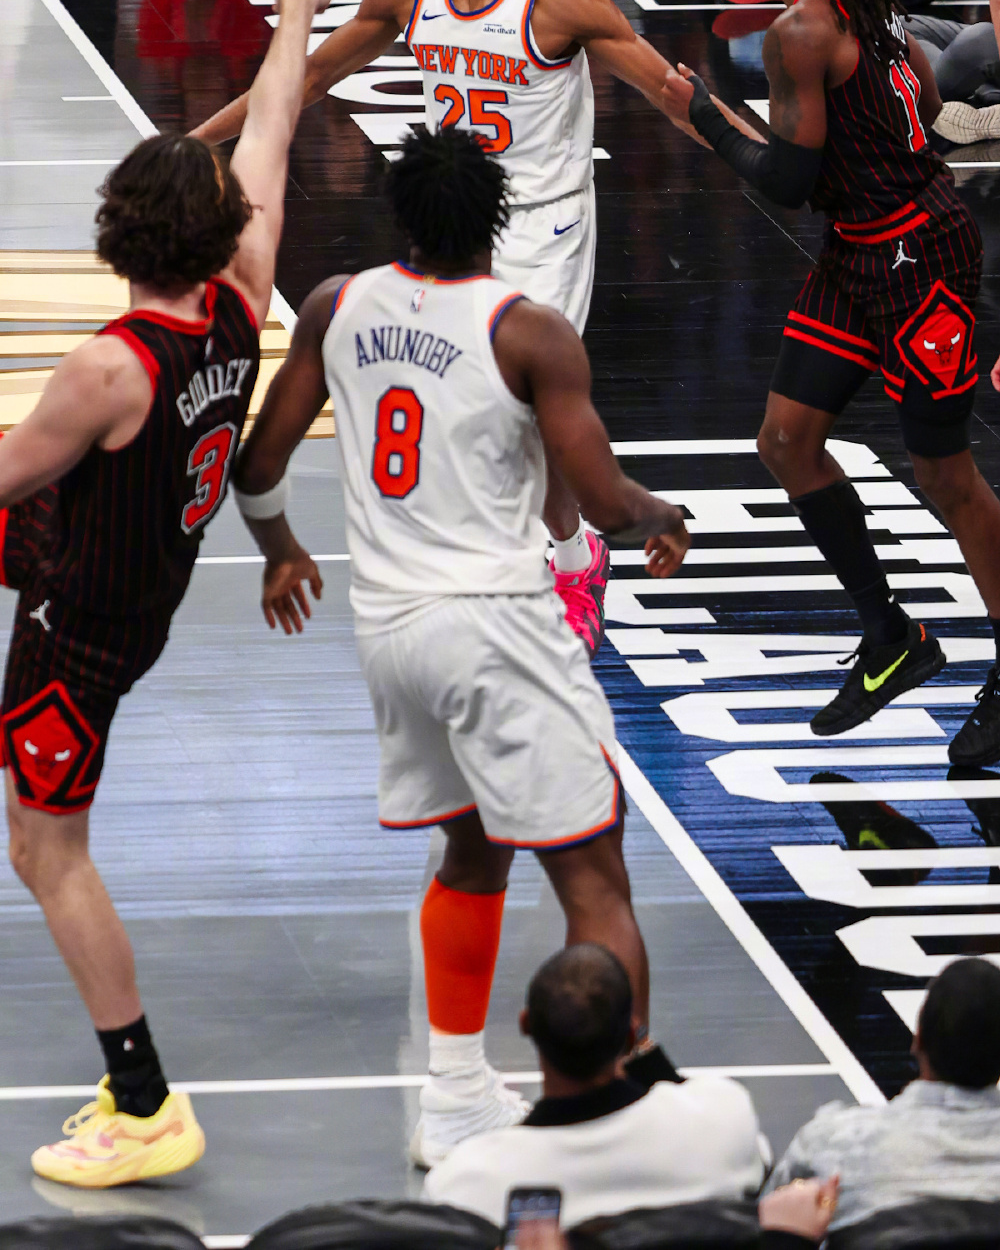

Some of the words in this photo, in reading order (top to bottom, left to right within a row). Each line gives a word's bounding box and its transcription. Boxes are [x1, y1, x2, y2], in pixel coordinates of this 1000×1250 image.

[412, 43, 458, 74] NEW
[458, 47, 529, 86] YORK
[433, 83, 514, 154] 25
[355, 326, 462, 379] ANUNOBY
[176, 358, 253, 427] GIDDEY
[371, 385, 424, 499] 8
[181, 421, 239, 535] 3
